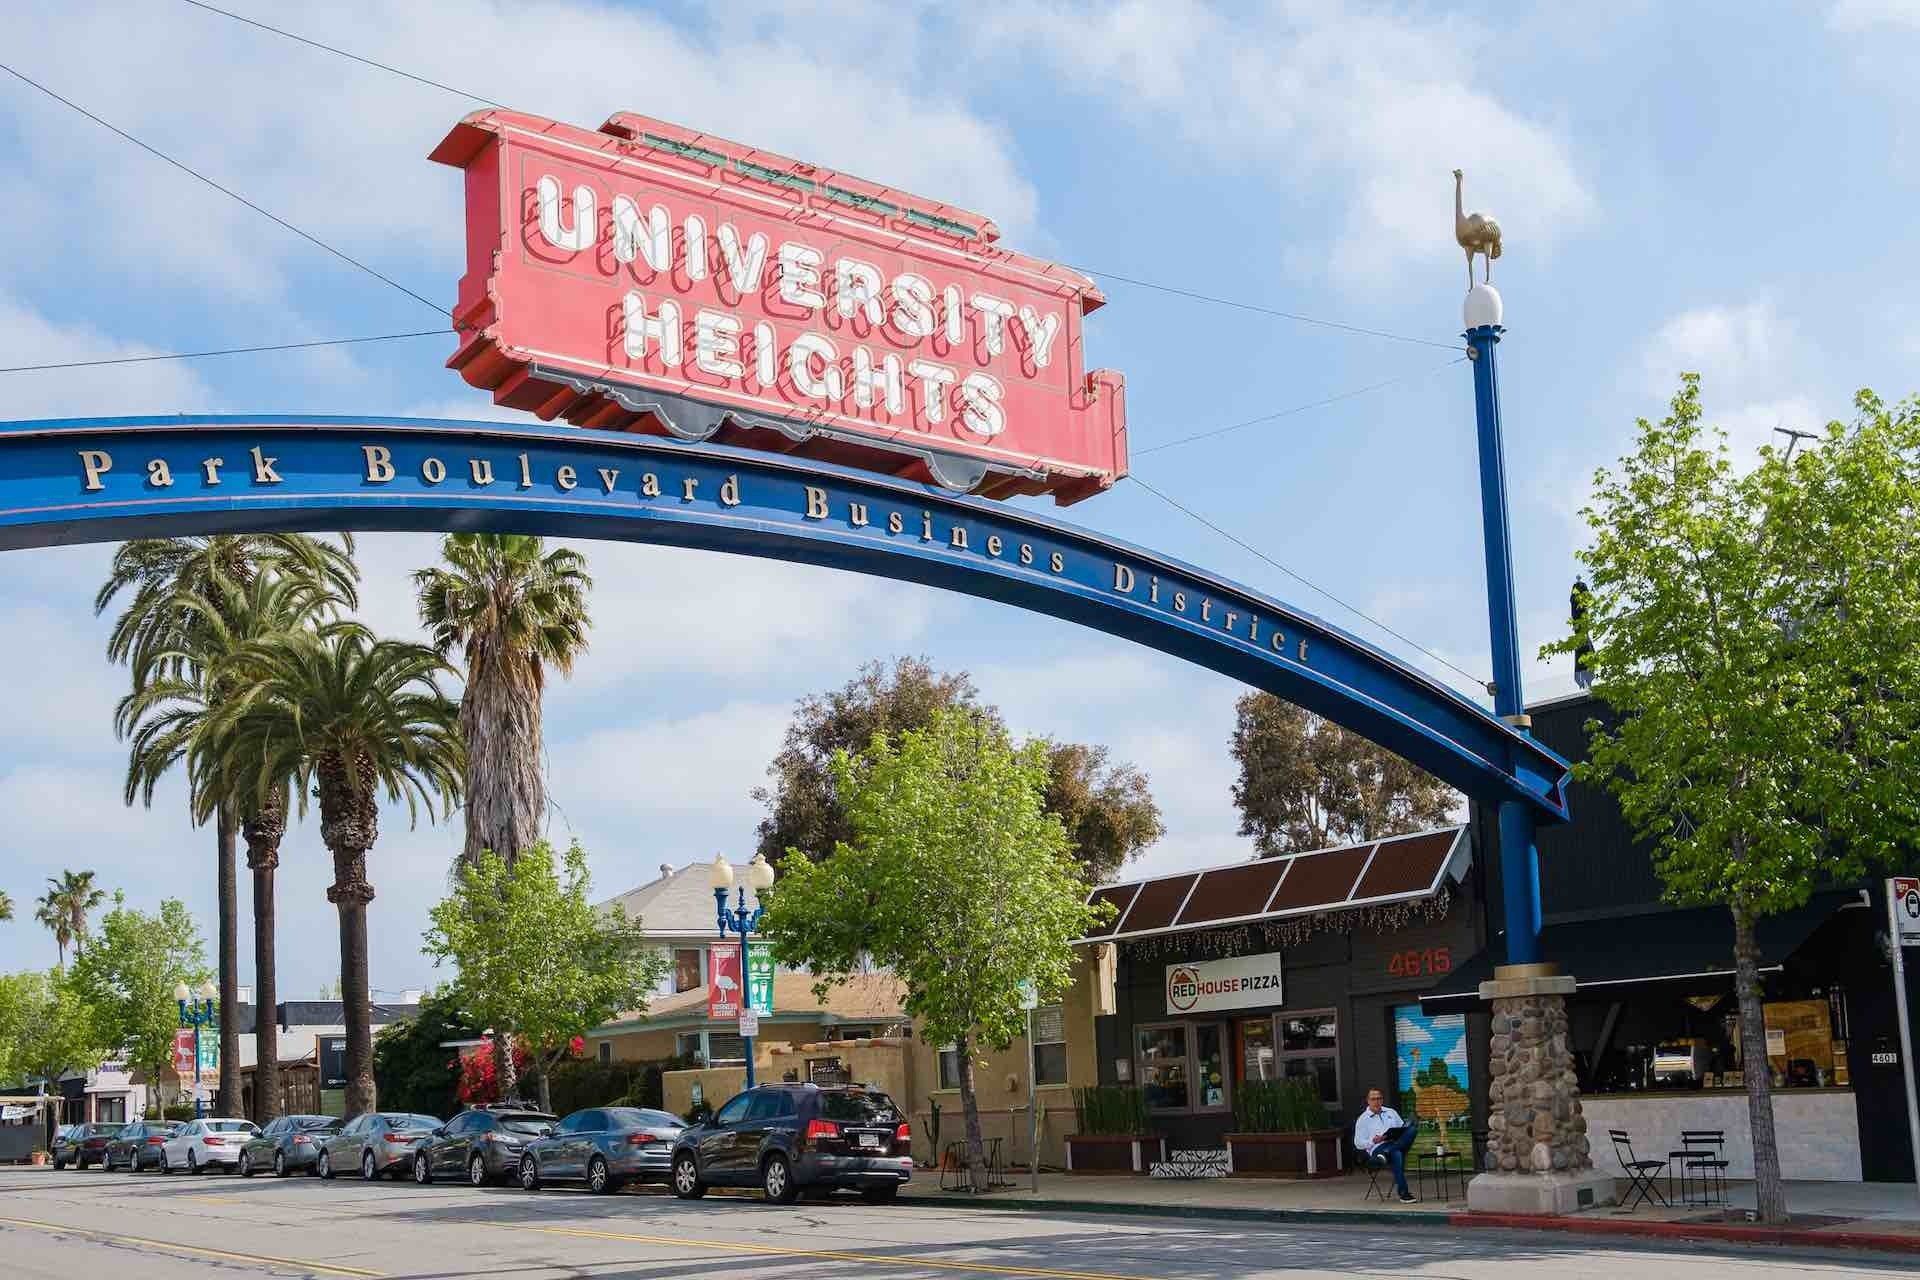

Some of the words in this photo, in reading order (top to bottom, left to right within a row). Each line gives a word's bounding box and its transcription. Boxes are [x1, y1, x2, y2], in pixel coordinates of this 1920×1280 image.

[537, 175, 1062, 368] UNIVERSITY
[623, 290, 1007, 436] HEIGHTS
[78, 445, 284, 490] Park
[361, 445, 742, 507] Boulevard
[805, 485, 1064, 573] Business
[1113, 562, 1310, 662] District
[1241, 975, 1280, 991] PIZZA
[1388, 948, 1451, 976] 4615
